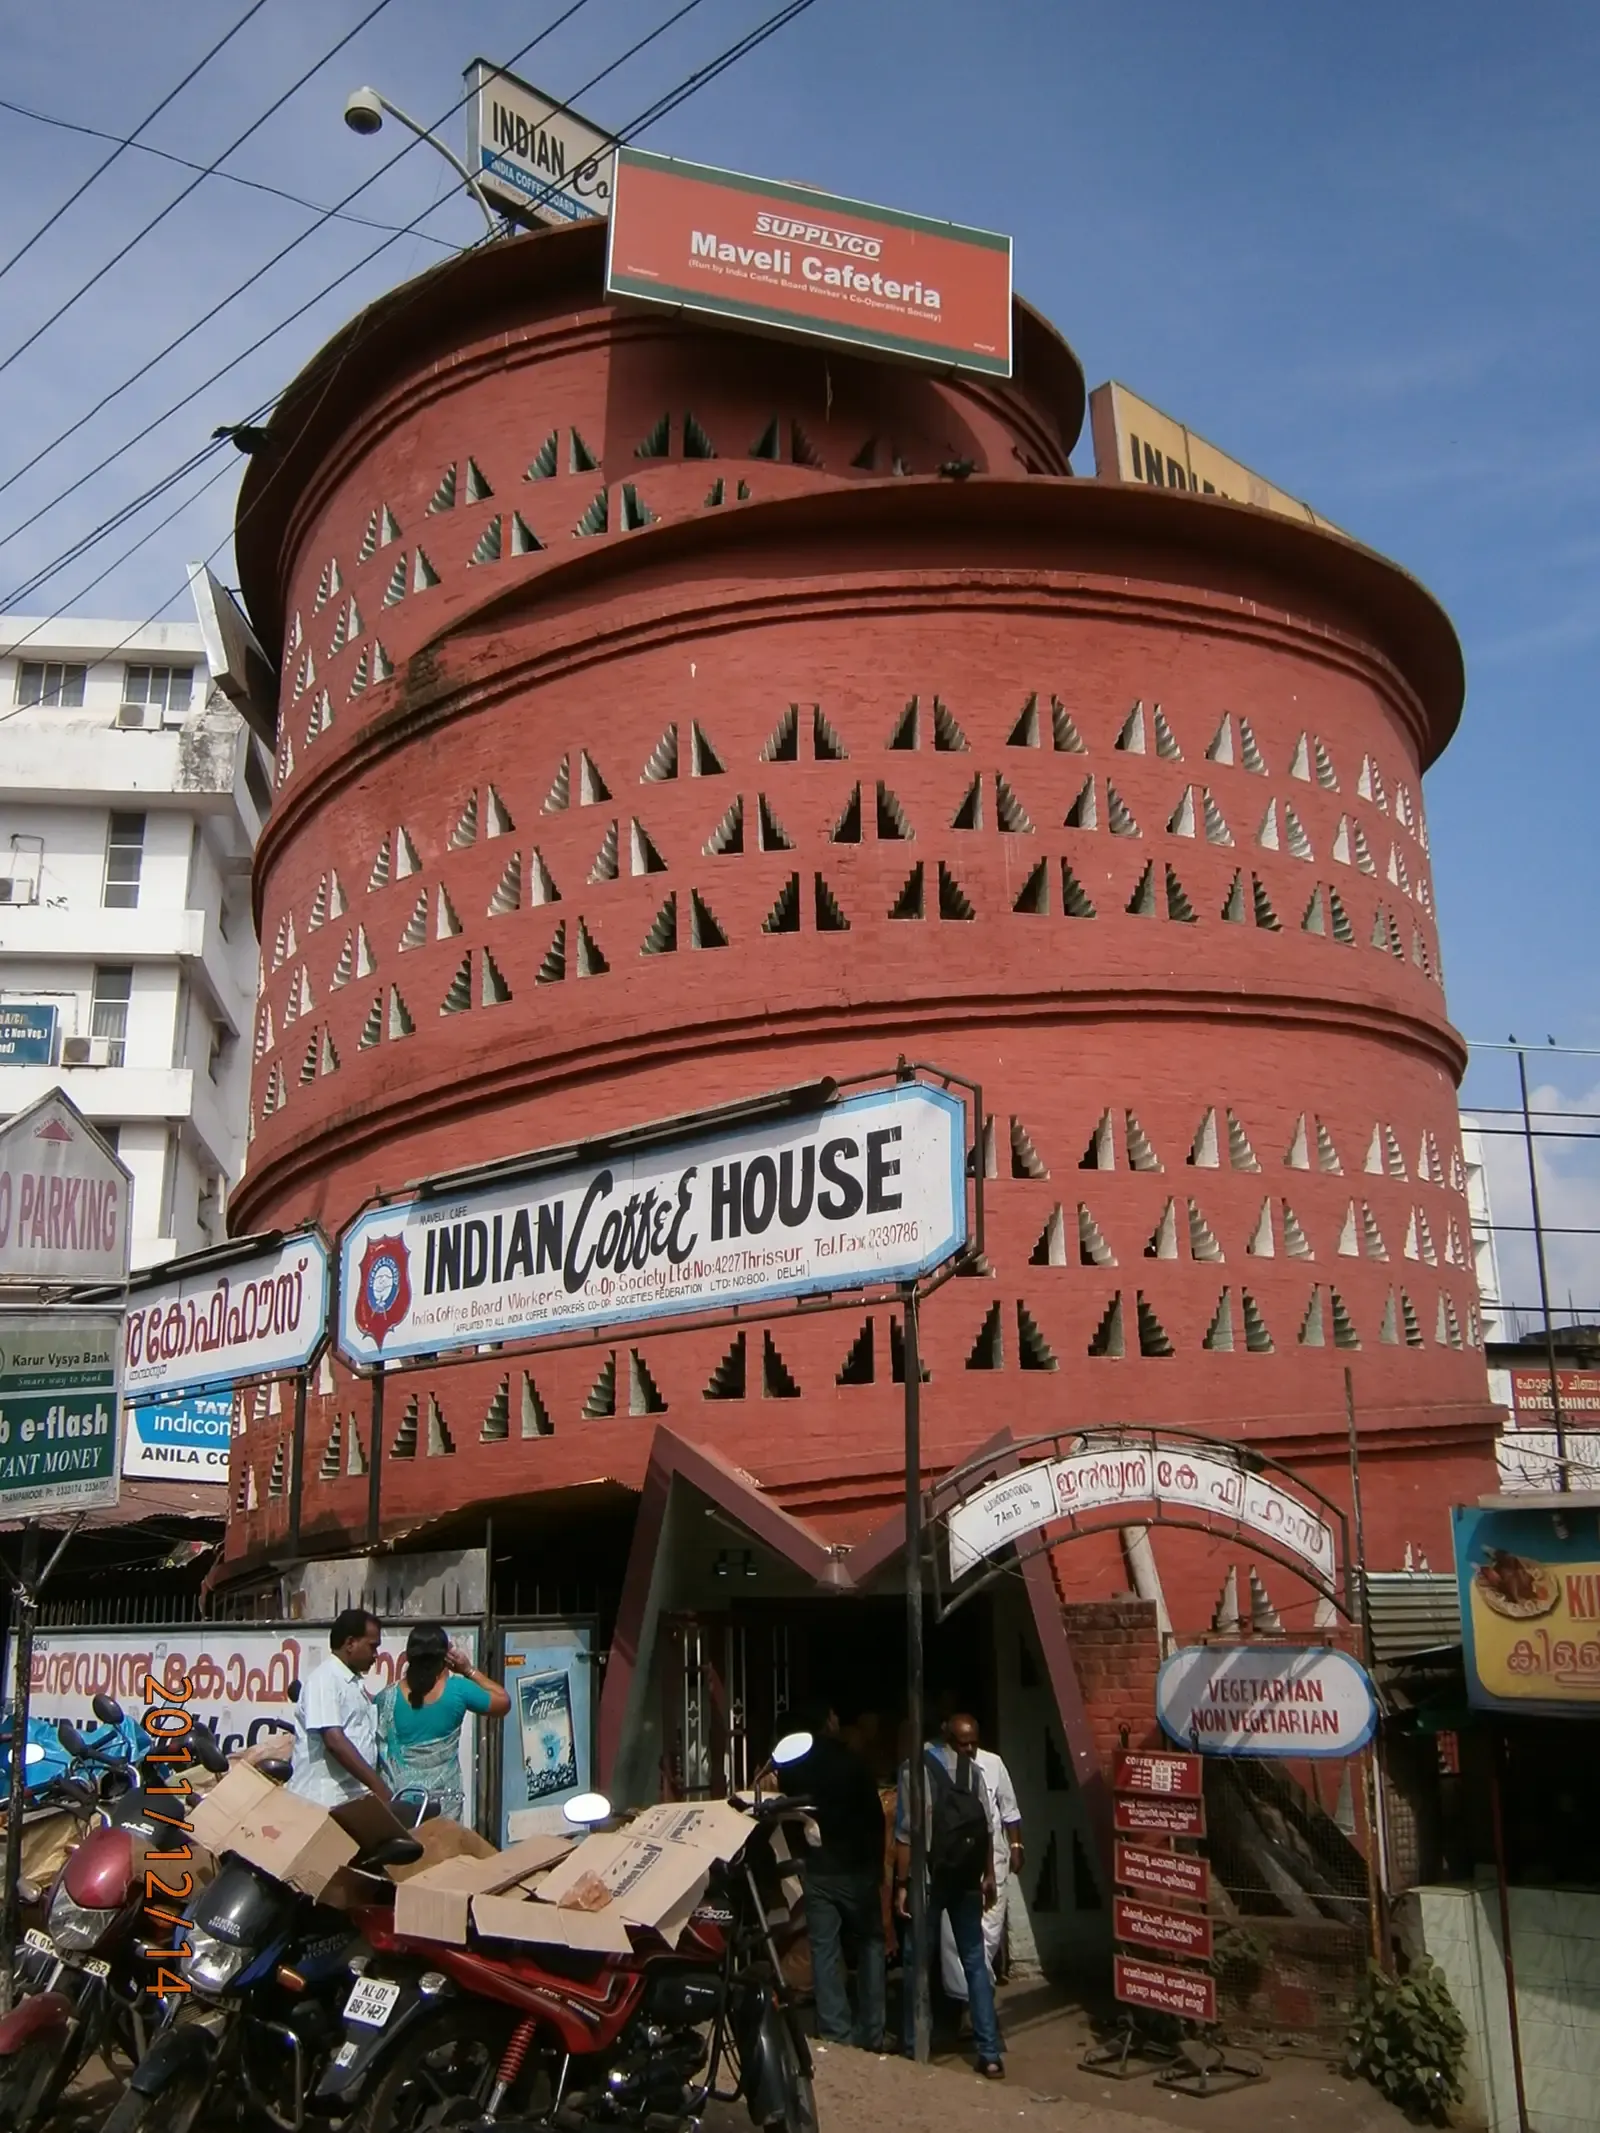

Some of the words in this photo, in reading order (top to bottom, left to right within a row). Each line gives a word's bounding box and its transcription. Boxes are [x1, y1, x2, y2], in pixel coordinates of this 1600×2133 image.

[492, 101, 565, 181] INDIAN
[756, 215, 881, 258] SUPPLYCO
[691, 230, 791, 275] Maveli
[801, 256, 941, 309] Cafeteria
[726, 265, 748, 279] India
[750, 271, 779, 286] Coffee
[781, 278, 808, 292] Board
[18, 1173, 118, 1252] PARKING
[424, 1200, 564, 1297] INDIAN
[711, 1125, 903, 1242] HOUSE
[450, 1205, 468, 1220] CAFE
[412, 1311, 435, 1327] India
[436, 1304, 469, 1323] Coffee
[471, 1296, 503, 1317] Board
[743, 1246, 804, 1271] Thrissur
[525, 1310, 549, 1321] COFFEE
[615, 1290, 654, 1307] SOCIETIES
[654, 1283, 703, 1300] FEDERATION
[12, 1354, 45, 1367] Karur
[48, 1352, 81, 1369] Vysya
[83, 1351, 111, 1364] Bank
[17, 1376, 46, 1387] Smart
[49, 1376, 67, 1388] way
[69, 1374, 78, 1384] to
[80, 1372, 103, 1383] bank
[1519, 1396, 1556, 1410] HOTEL
[20, 1403, 109, 1443] e-flash
[43, 1446, 103, 1474] MONEY
[141, 1446, 200, 1465] ANILA
[164, 1638, 301, 1703] കോഫി
[1208, 1679, 1324, 1703] VEGETARIAN
[1191, 1708, 1228, 1733] NON
[1230, 1708, 1340, 1734] VEGETARIAN
[1125, 1755, 1154, 1768] COFFEE
